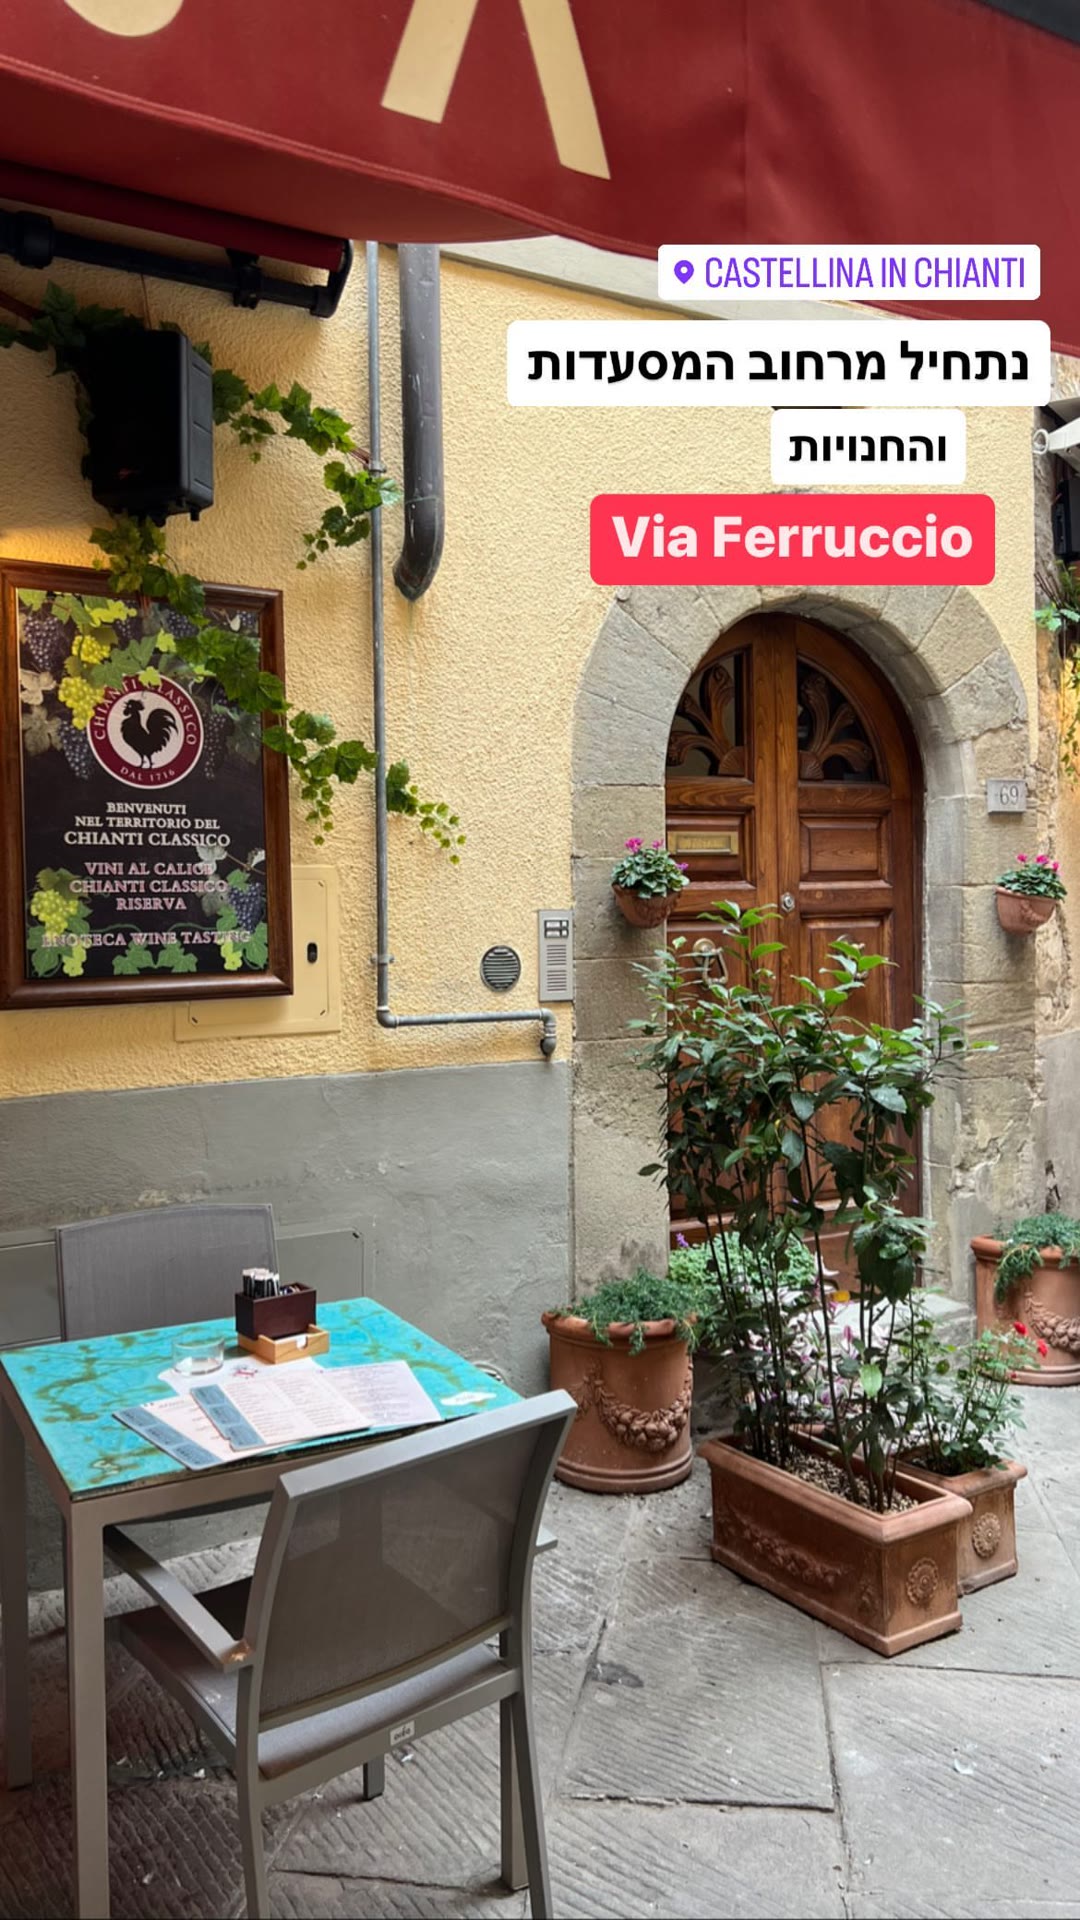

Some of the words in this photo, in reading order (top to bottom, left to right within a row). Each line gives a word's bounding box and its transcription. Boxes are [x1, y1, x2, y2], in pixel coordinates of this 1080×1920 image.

[94, 679, 137, 740] CHIANTI
[147, 682, 197, 746] LASSICO
[120, 766, 142, 781] DAL
[149, 769, 175, 782] 1716
[1000, 784, 1019, 806] 69
[106, 802, 187, 815] BENVENUTI
[75, 816, 103, 827] NEL
[106, 817, 192, 829] TERRITORIO
[194, 819, 220, 829] DEL
[64, 831, 144, 846] CHIANTI
[148, 833, 231, 847] CLASSICO
[84, 862, 124, 876] VINI
[128, 862, 149, 876] AL
[154, 862, 214, 876] CALICE
[69, 880, 145, 893] CHIANTI
[150, 880, 229, 893] CLASSICO
[116, 897, 187, 911] RISERVA
[41, 932, 127, 947] ENOTECA
[130, 931, 178, 945] WINE
[180, 930, 251, 944] TASTING
